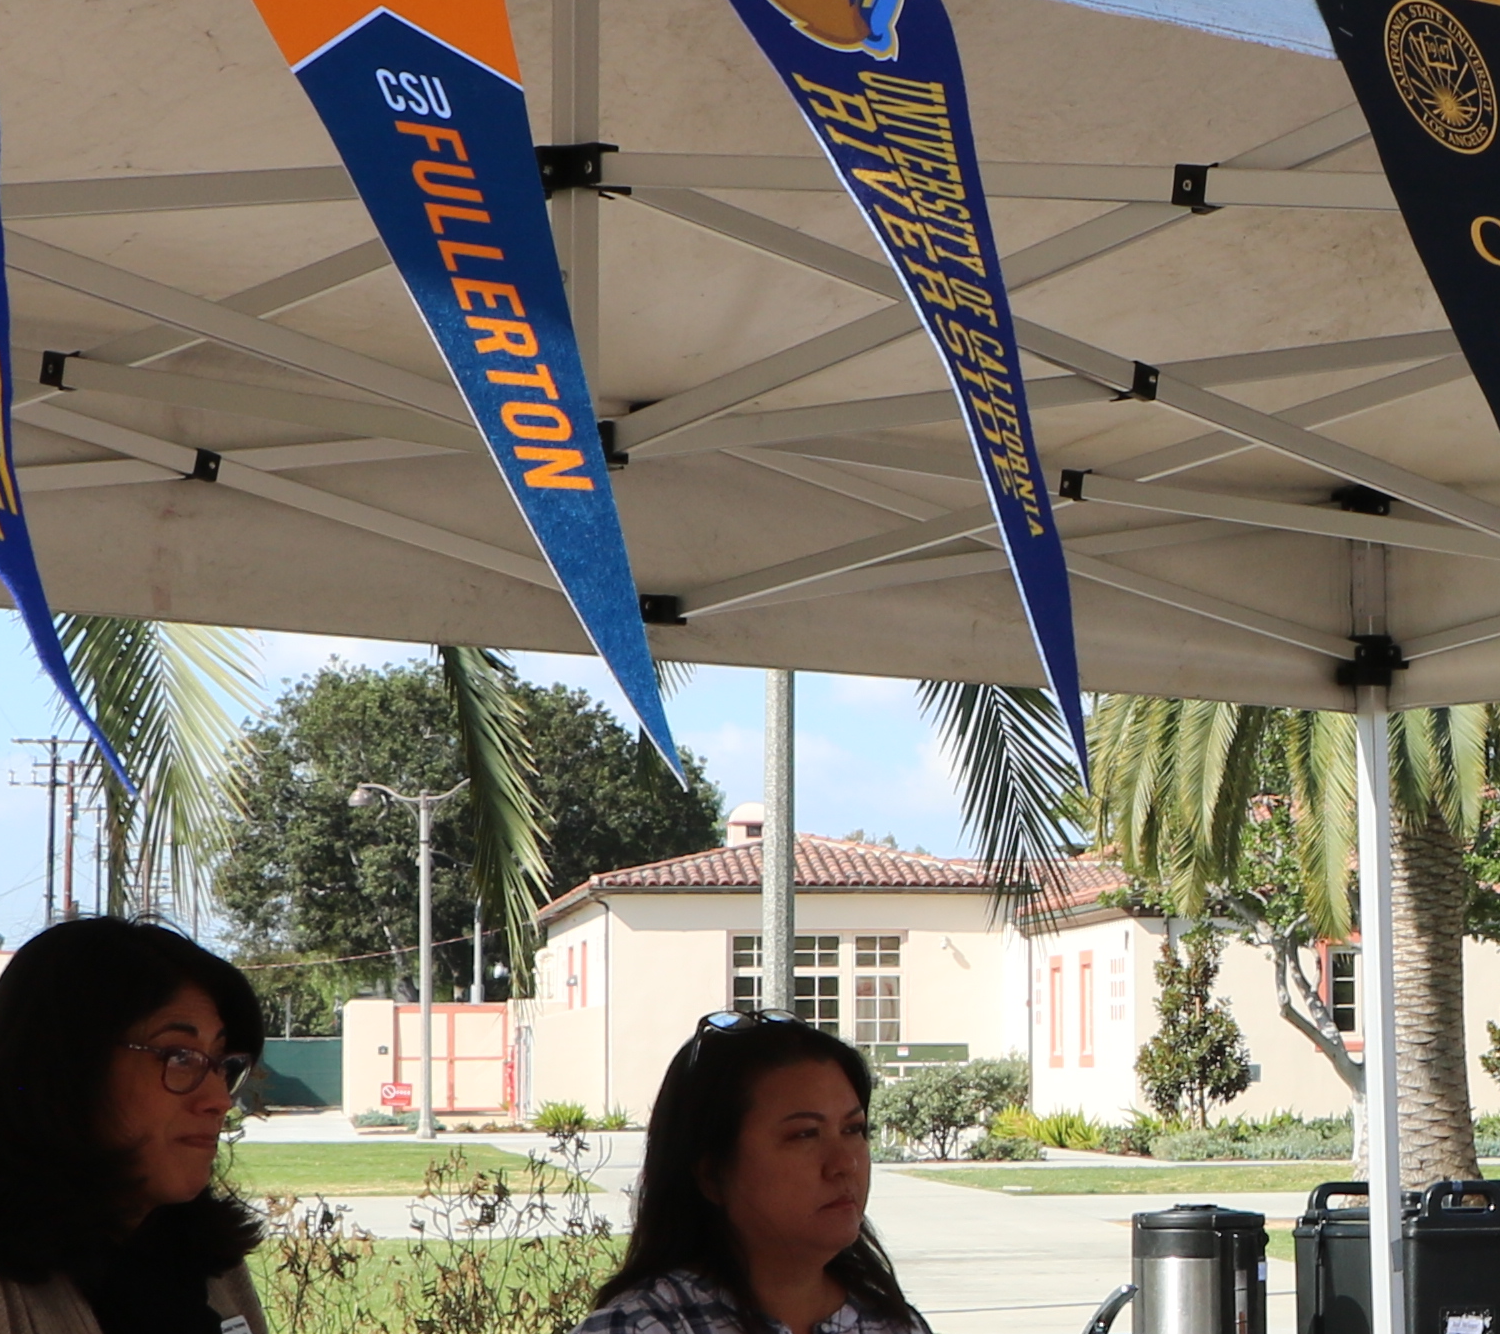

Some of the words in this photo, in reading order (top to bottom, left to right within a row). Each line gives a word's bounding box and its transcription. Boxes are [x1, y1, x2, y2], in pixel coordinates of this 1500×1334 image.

[1389, 11, 1415, 100] CALIFORNIA
[1409, 4, 1443, 23] STATE
[376, 68, 452, 119] CSU
[1448, 21, 1492, 115] UNIVERSITY
[1423, 113, 1445, 138] LOS
[1448, 122, 1489, 146] ANGELES
[857, 71, 986, 278] UNIVERSITY
[394, 120, 594, 491] FULLERTON
[792, 72, 1015, 496] RIVERSIDE
[949, 278, 998, 328] OF
[972, 330, 1046, 538] CALIFORNIA
